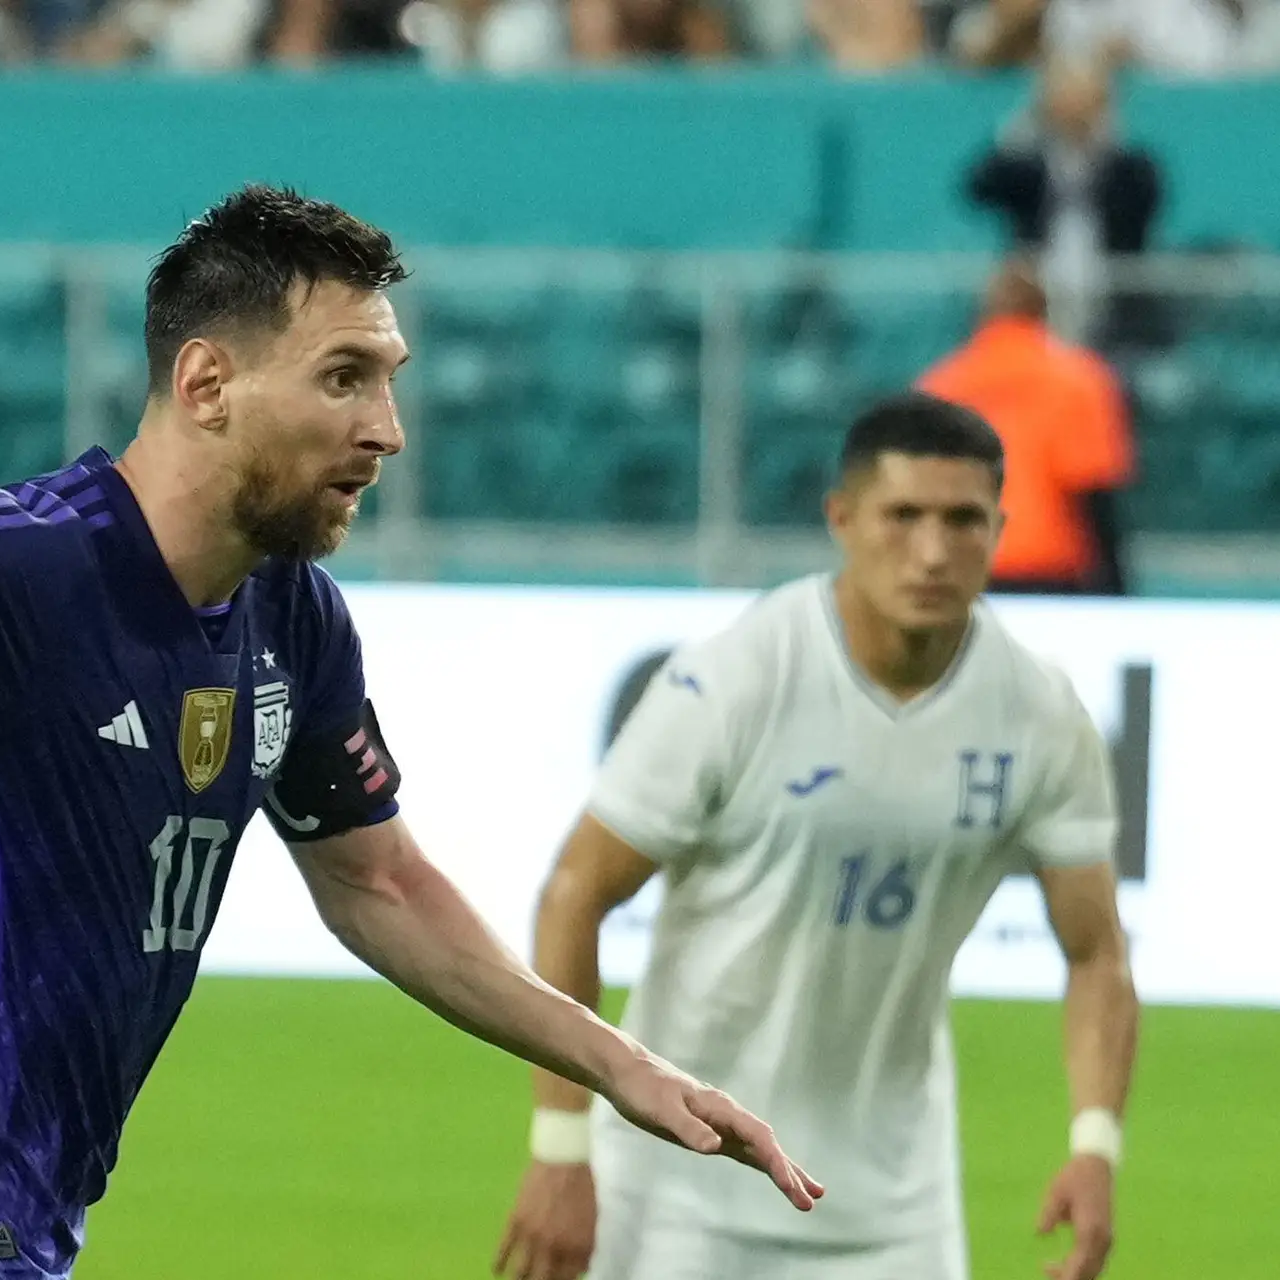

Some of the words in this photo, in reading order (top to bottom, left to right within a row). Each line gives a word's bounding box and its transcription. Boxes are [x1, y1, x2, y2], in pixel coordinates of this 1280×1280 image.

[954, 749, 1015, 829] H
[142, 814, 230, 954] 10
[830, 853, 917, 929] 16
